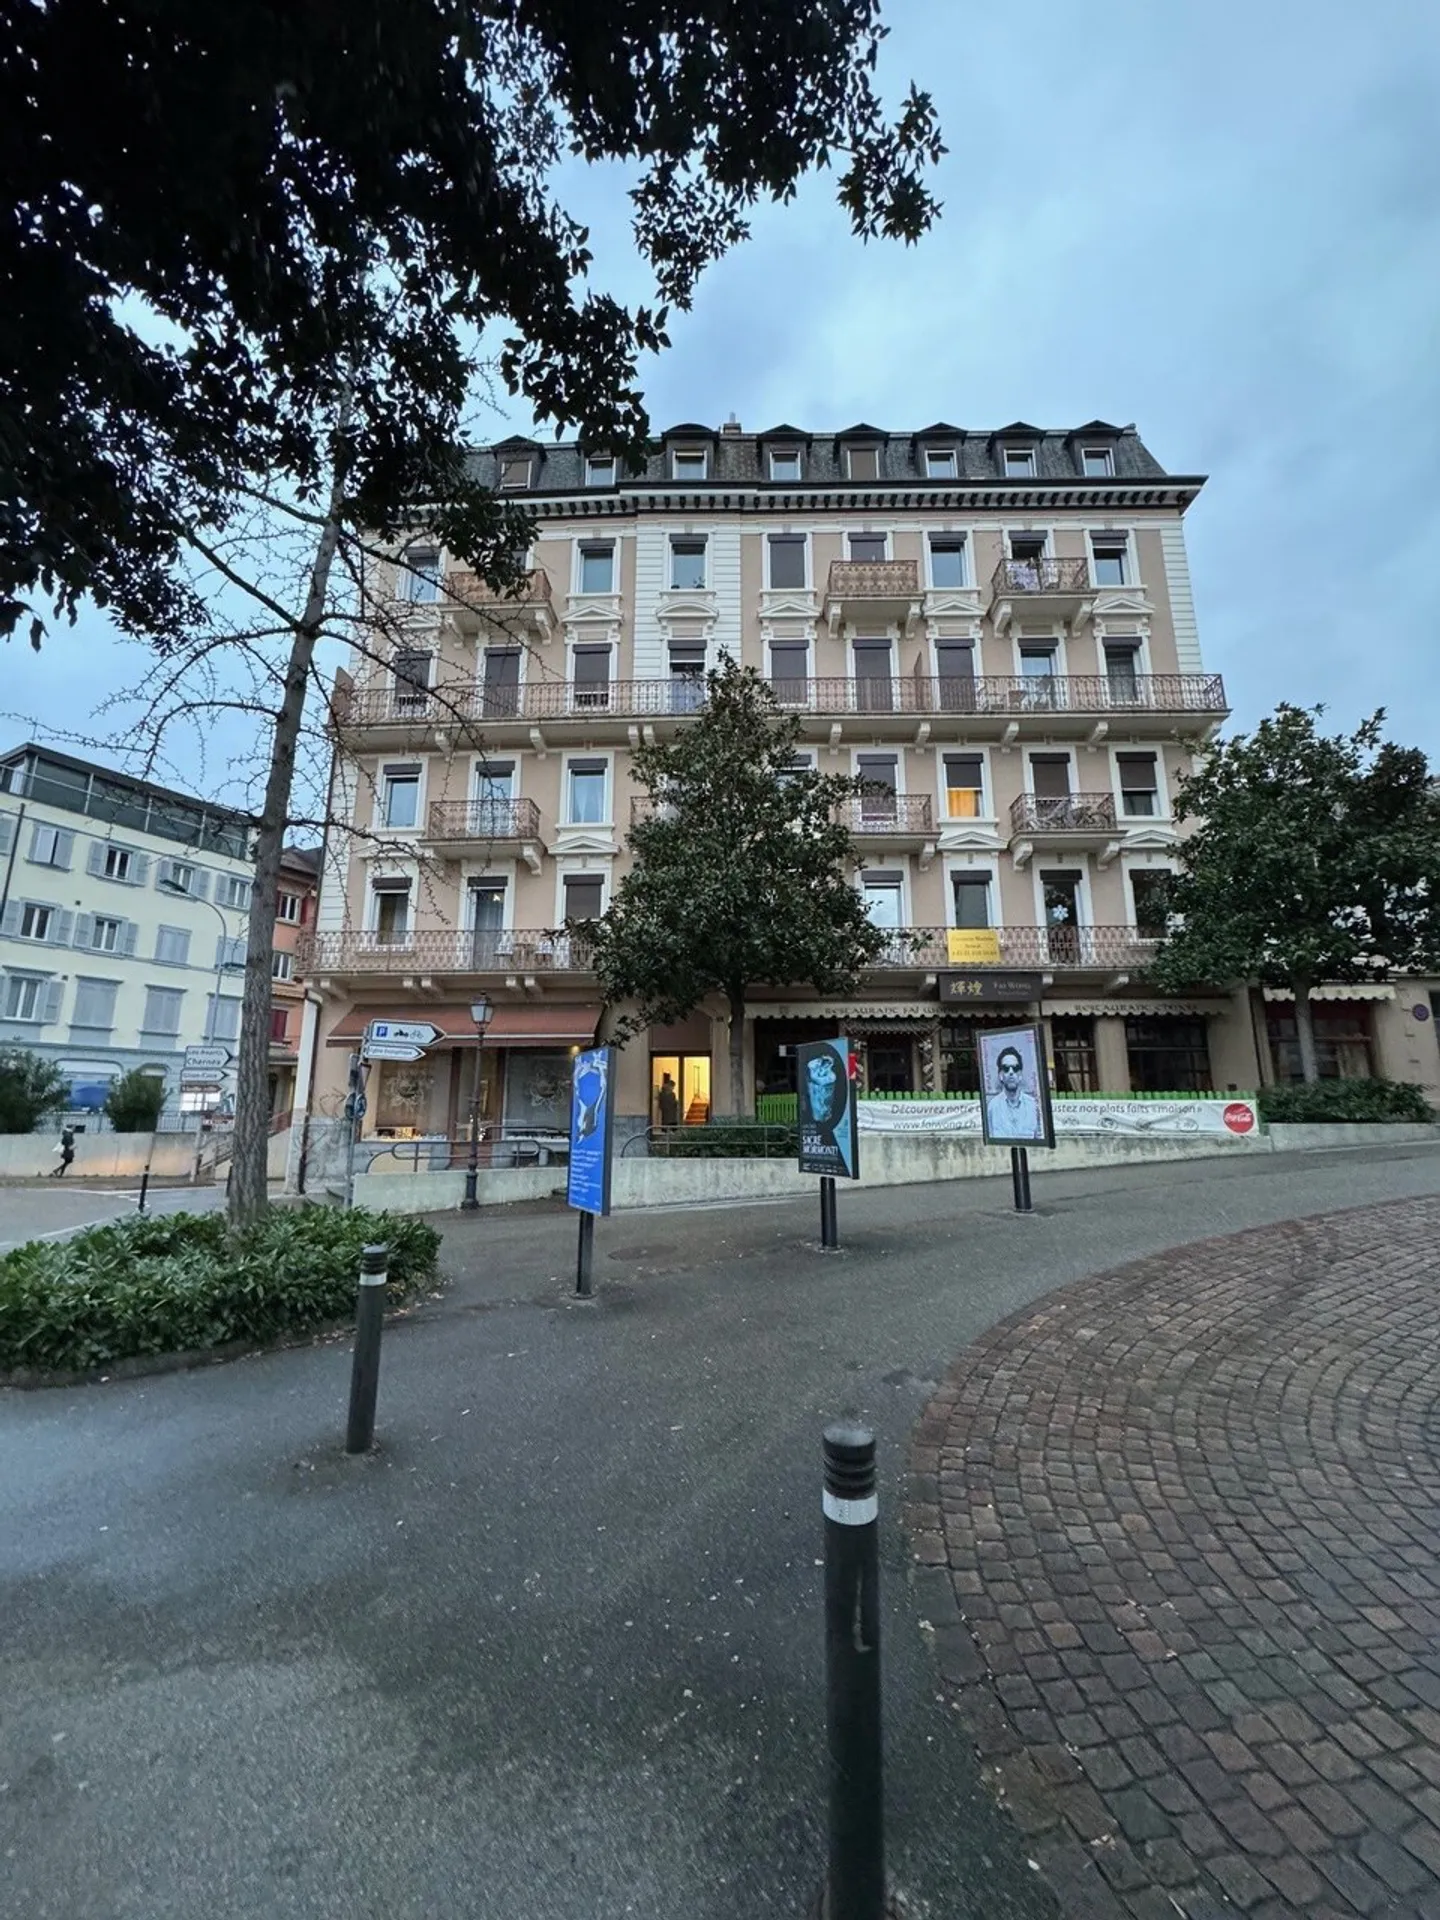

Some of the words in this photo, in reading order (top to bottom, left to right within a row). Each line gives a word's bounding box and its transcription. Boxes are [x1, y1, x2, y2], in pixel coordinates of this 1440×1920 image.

[890, 1103, 944, 1114] Découvrez
[1079, 1105, 1098, 1113] nos
[1100, 1103, 1125, 1115] plats
[1126, 1102, 1149, 1113] faits
